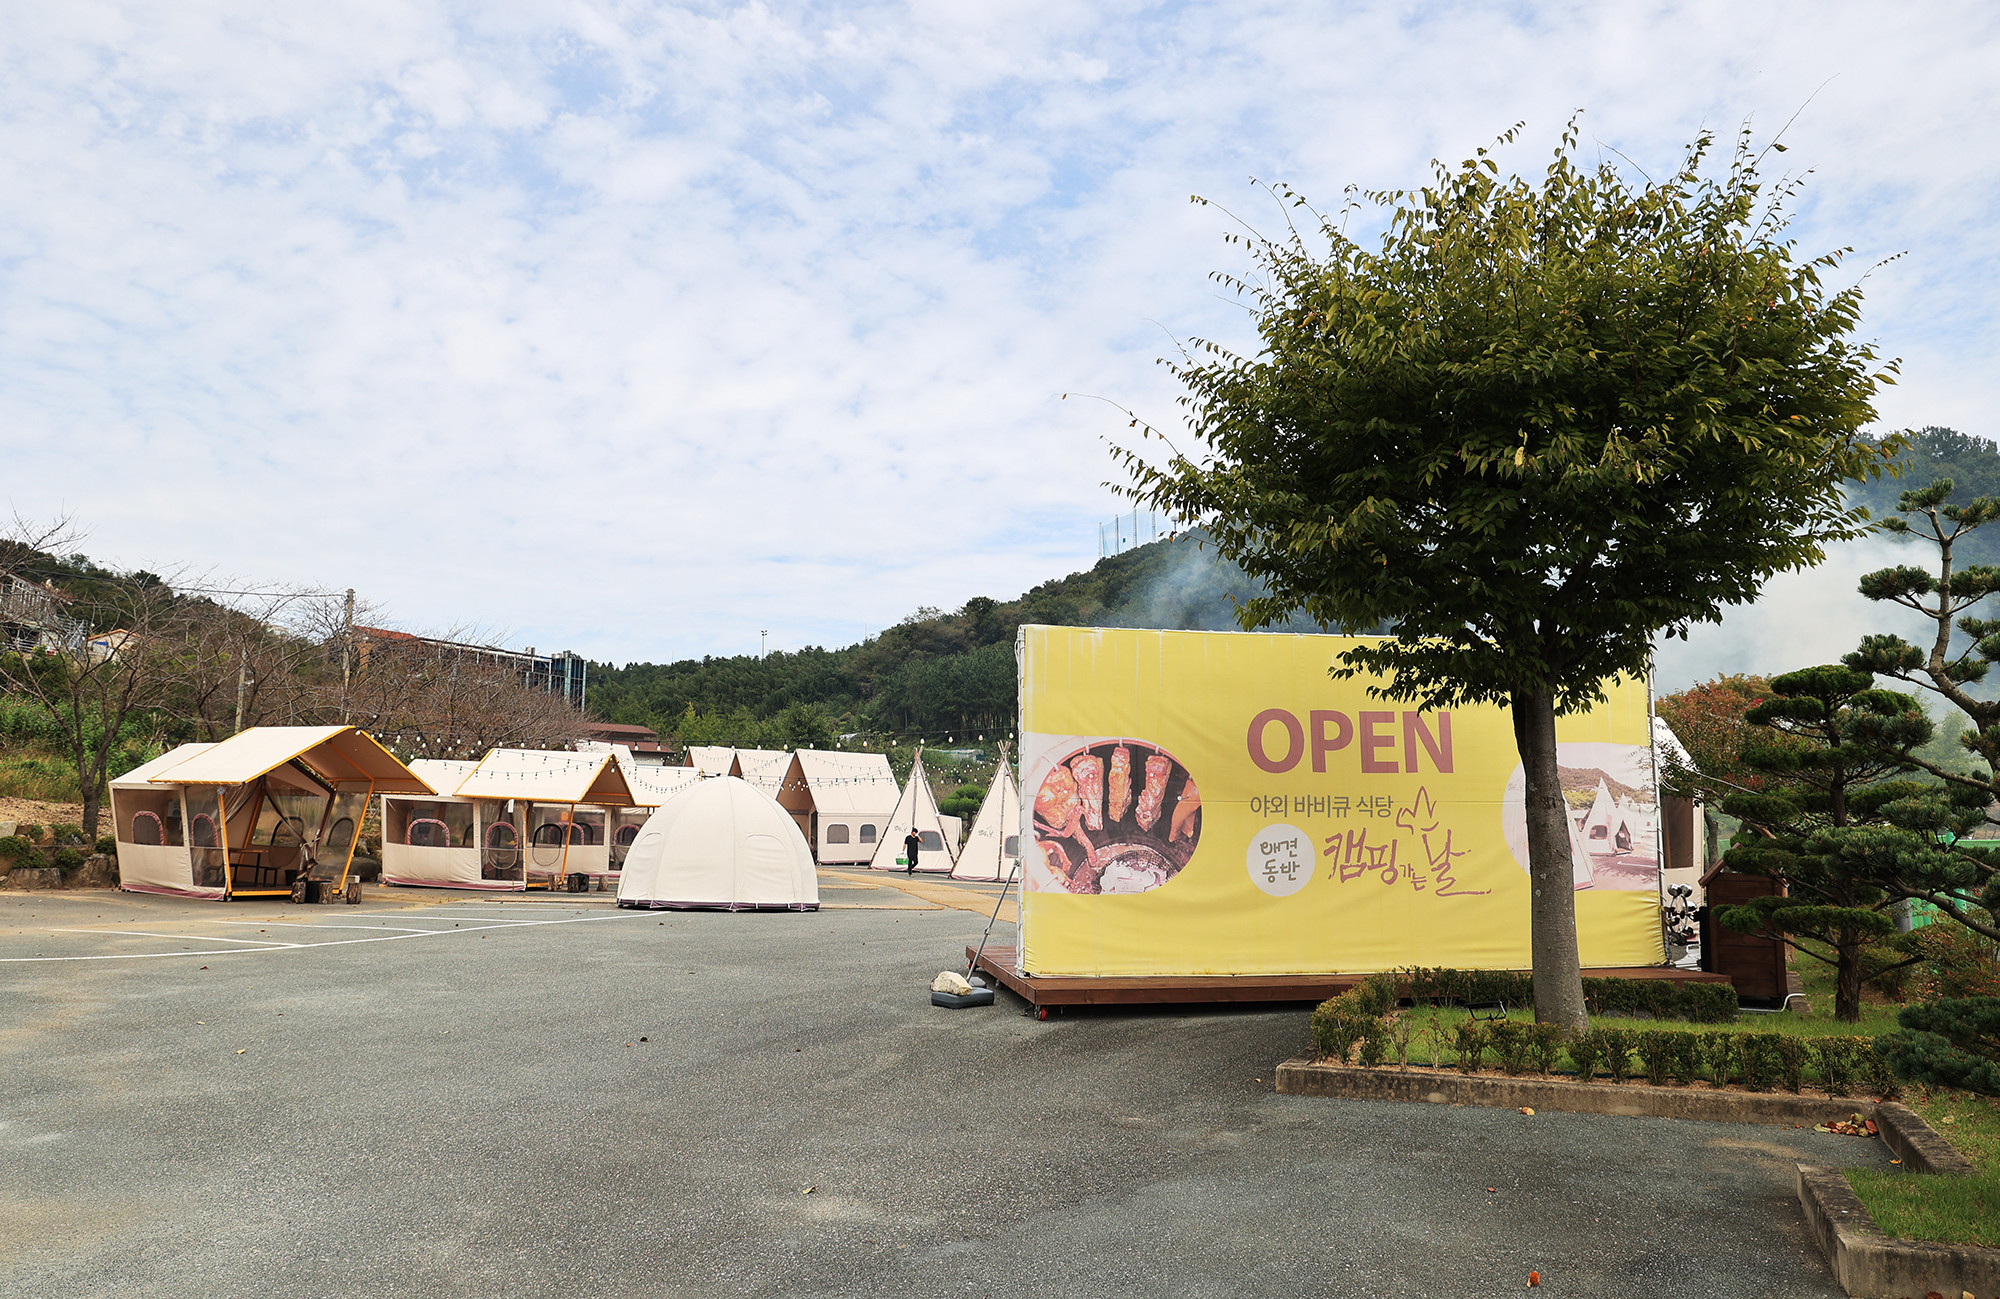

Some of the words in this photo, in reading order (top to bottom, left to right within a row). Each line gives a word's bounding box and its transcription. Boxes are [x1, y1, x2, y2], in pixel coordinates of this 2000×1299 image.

[1247, 708, 1454, 774] OPEN
[1250, 794, 1288, 818] 야외
[1294, 794, 1351, 818] 바비큐
[1356, 795, 1394, 818] 식당
[1259, 837, 1298, 858] 애견
[1262, 859, 1300, 883] 동반
